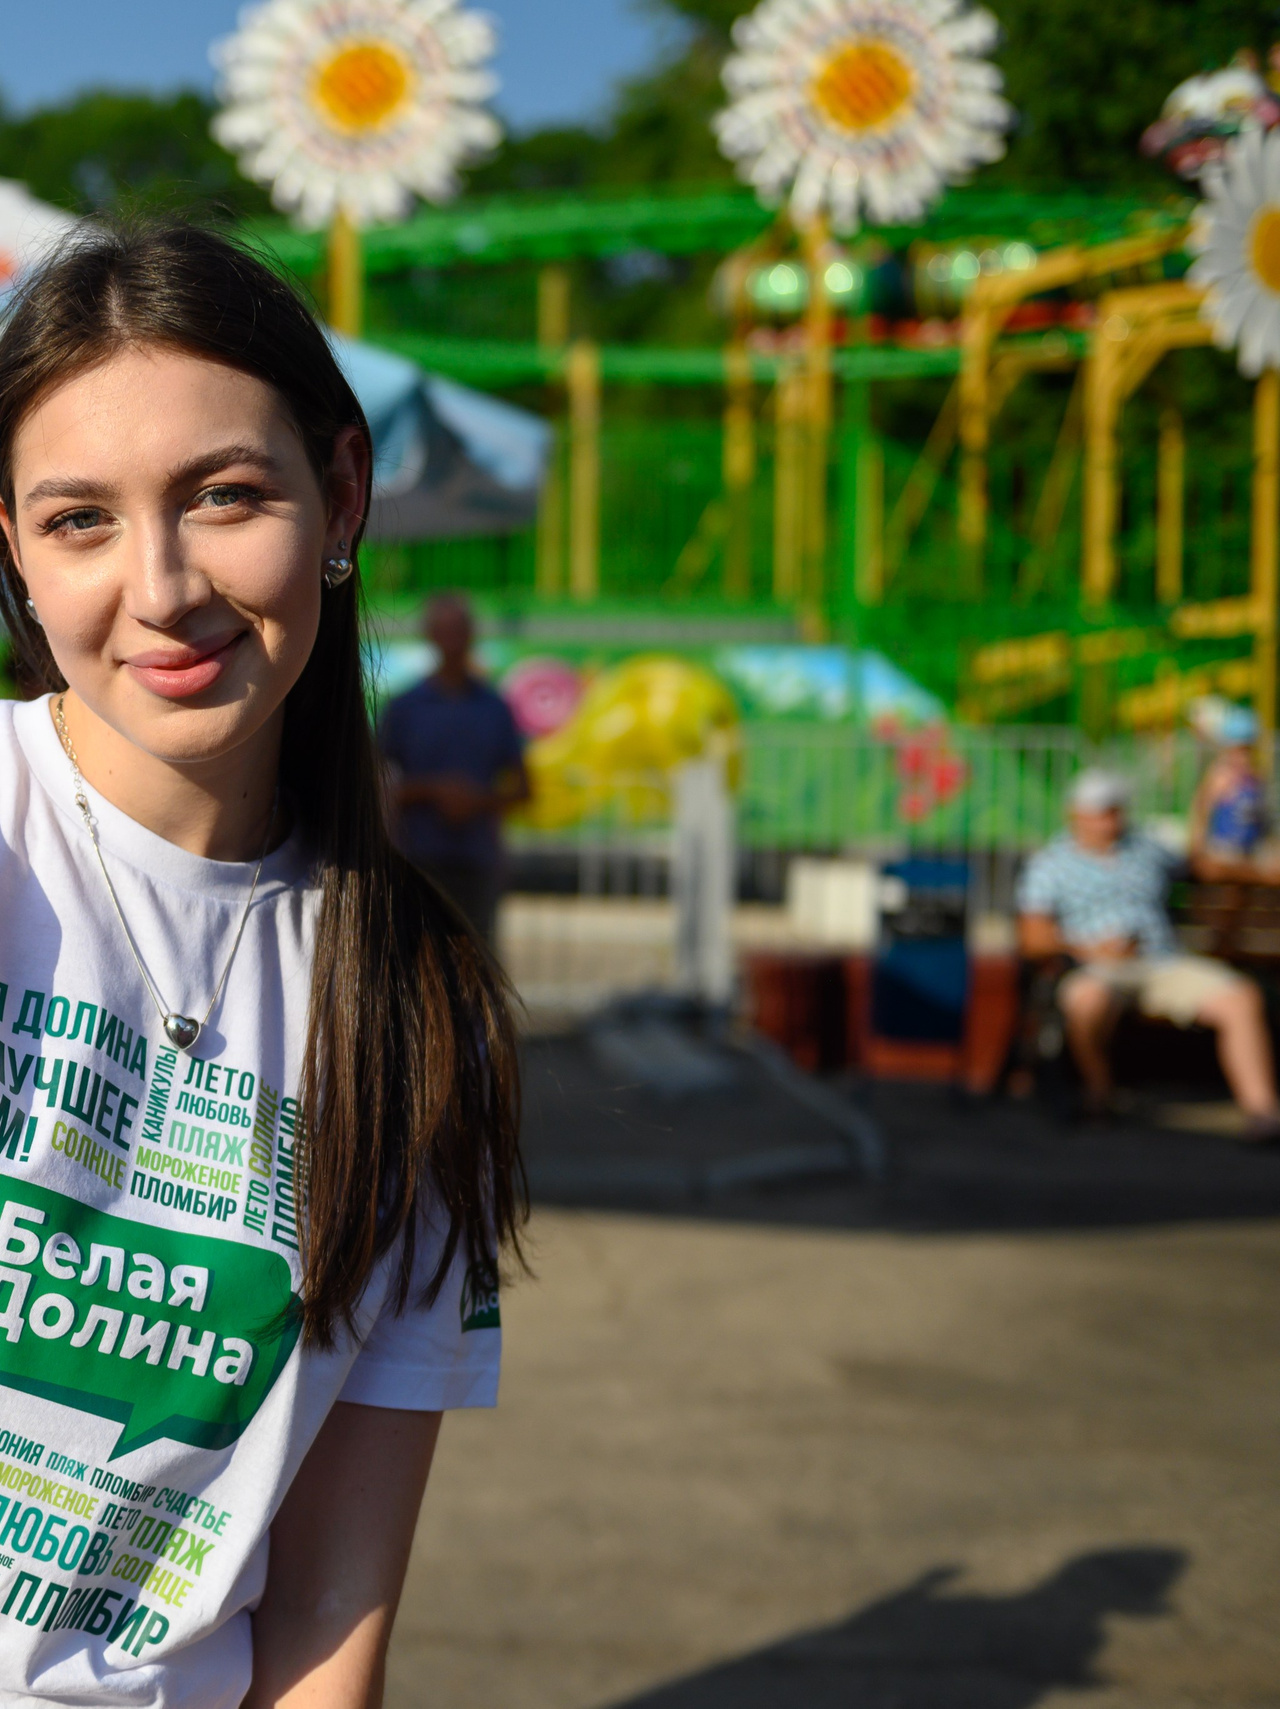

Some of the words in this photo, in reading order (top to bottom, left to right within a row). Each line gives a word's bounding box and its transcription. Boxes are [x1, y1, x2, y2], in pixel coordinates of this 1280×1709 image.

[12, 989, 149, 1081] ДОЛИНА
[141, 1044, 178, 1143] КАНИКУЛЫ
[183, 1057, 256, 1101] ЛЕТО
[175, 1091, 252, 1129] ЛЮБОВЬ
[248, 1077, 278, 1180] СОЛНЦЕ
[51, 1120, 127, 1190] СОЛНЦЕ
[135, 1145, 242, 1195] МОРОЖЕНОЕ
[168, 1120, 248, 1167] ПЛЯЖ
[129, 1170, 238, 1222] ПЛОМБИР
[243, 1179, 270, 1236] ЛЕТО
[45, 1451, 90, 1482] ПЛЯЖ
[88, 1467, 157, 1504] ПЛОМБИР
[152, 1487, 233, 1538] СЧАСТЬЕ
[98, 1502, 142, 1531] ЛЕТО
[128, 1515, 216, 1577] ПЛЯЖ
[111, 1553, 195, 1609] СОЛНЦЕ
[0, 1570, 171, 1659] ПЛОМБИР
